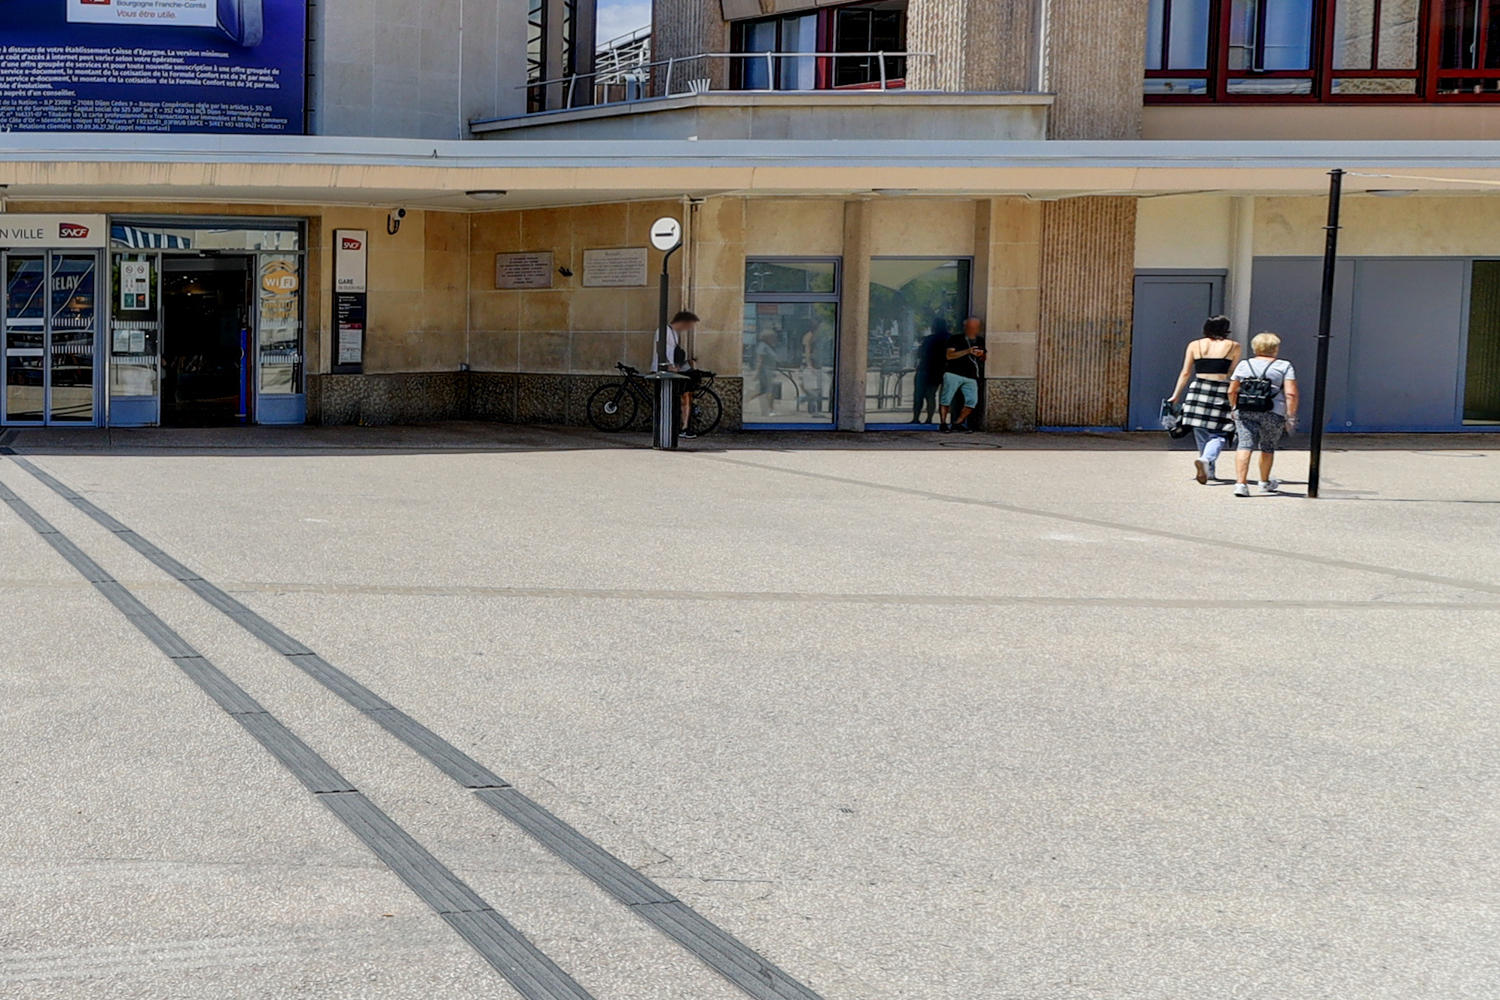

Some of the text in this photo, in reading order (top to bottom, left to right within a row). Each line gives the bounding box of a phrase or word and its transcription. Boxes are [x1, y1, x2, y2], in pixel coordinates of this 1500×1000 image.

[116, 0, 207, 9] Bourgogne Franche-Comté
[116, 10, 178, 19] Vous être utile.
[12, 228, 44, 239] VILLE
[60, 228, 88, 238] SNCF
